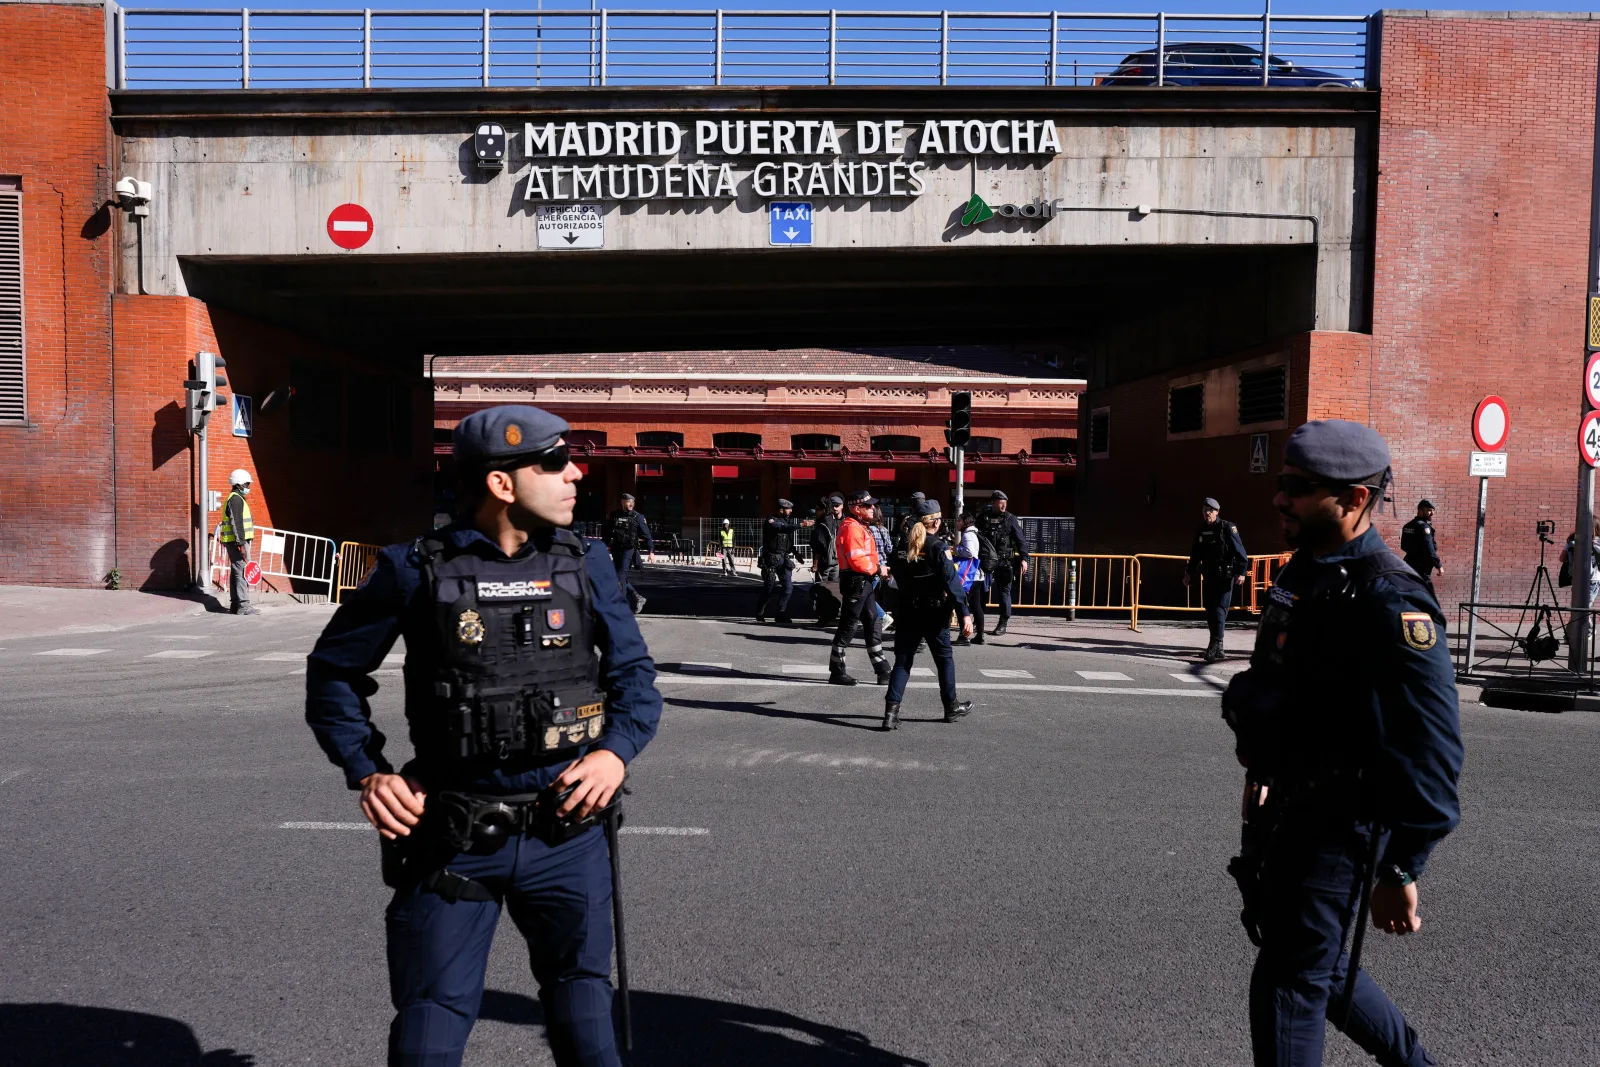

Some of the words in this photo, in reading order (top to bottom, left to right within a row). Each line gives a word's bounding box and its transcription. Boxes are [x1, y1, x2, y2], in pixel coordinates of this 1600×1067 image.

[525, 121, 681, 157] MADRID
[696, 120, 842, 155] PUERTA
[857, 120, 904, 155] DE
[919, 119, 1062, 154] ATOCHA
[524, 162, 738, 200] ALMUDENA
[753, 161, 926, 197] GRANDES
[773, 206, 809, 220] TAXI
[998, 196, 1064, 218] adif
[539, 222, 603, 230] AUTORIZADOS
[478, 581, 536, 590] POLICIA
[479, 588, 552, 597] NACIONAL
